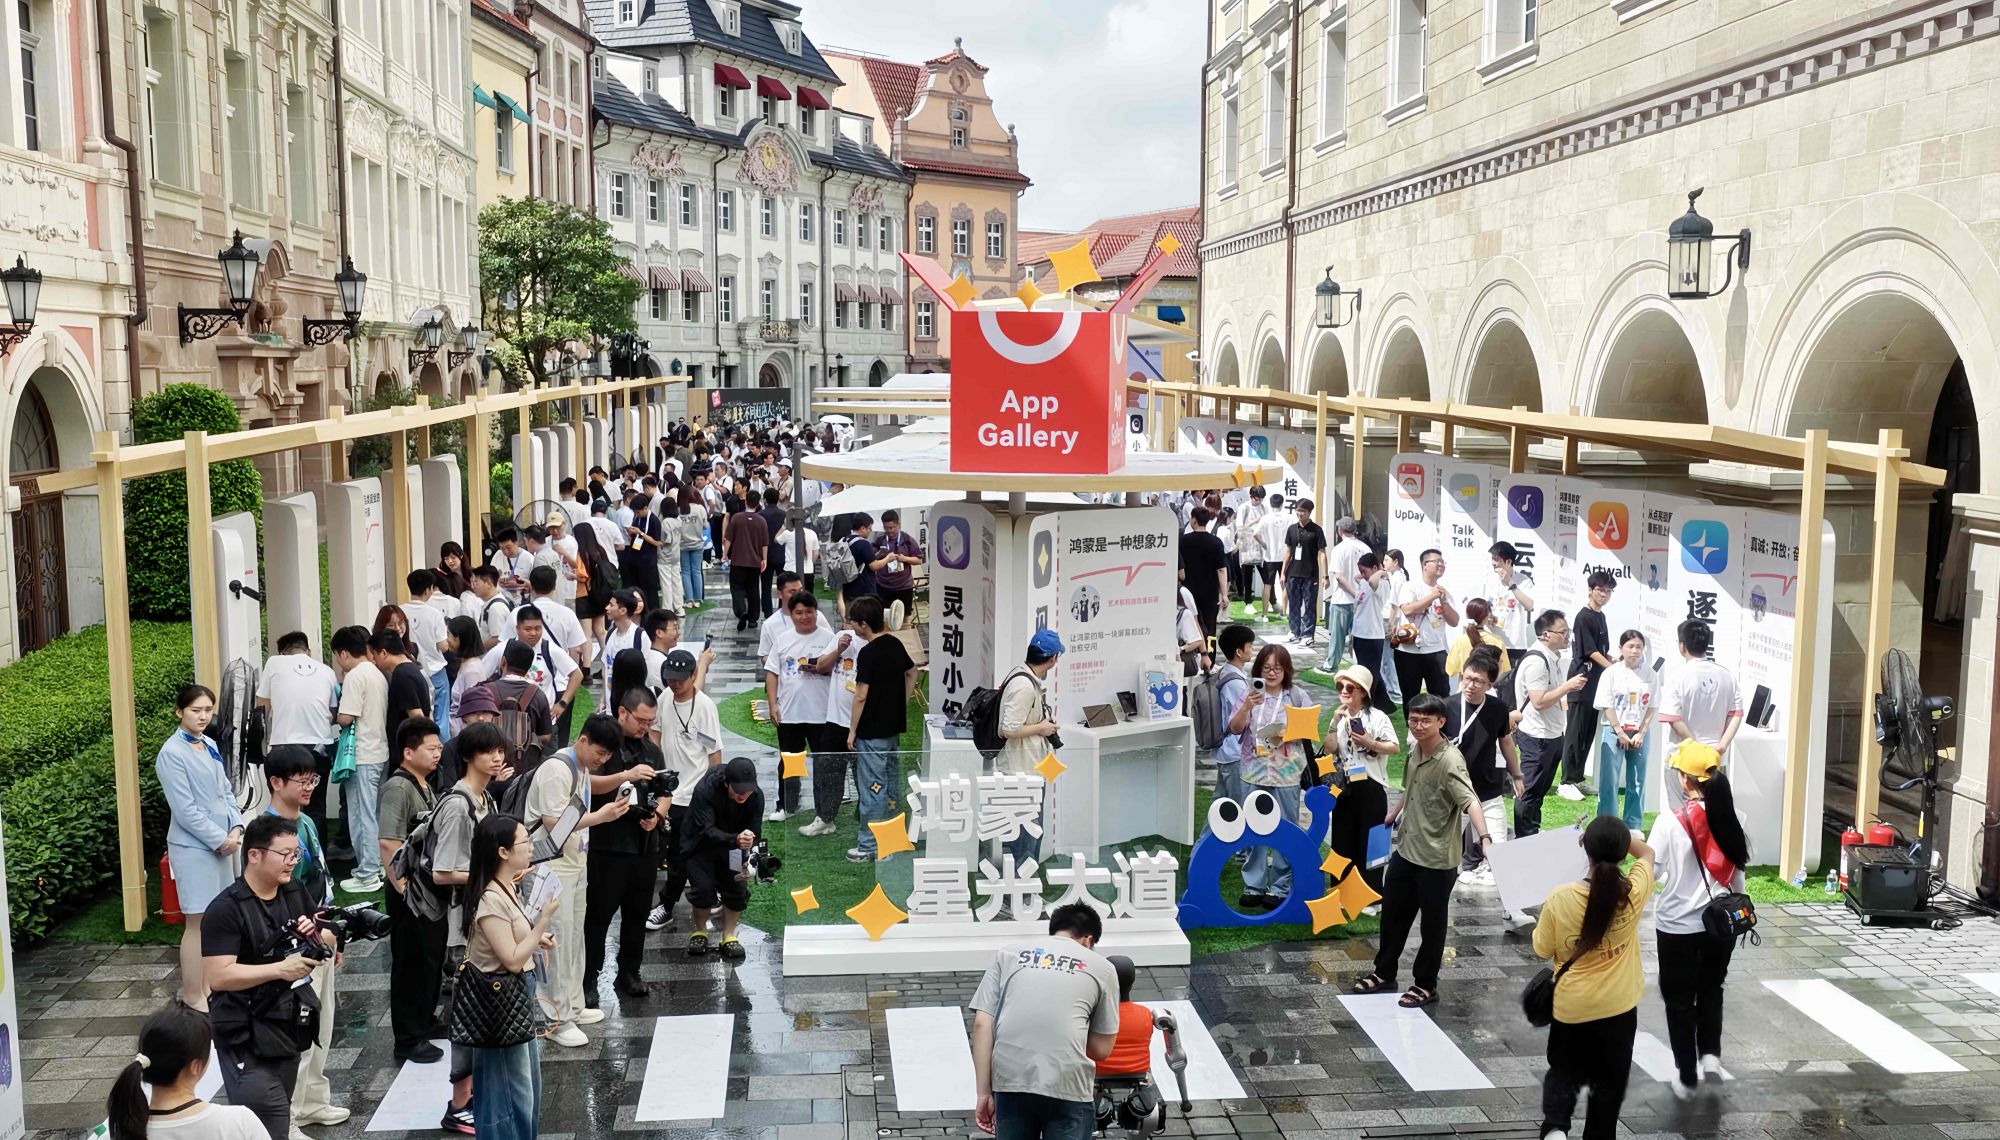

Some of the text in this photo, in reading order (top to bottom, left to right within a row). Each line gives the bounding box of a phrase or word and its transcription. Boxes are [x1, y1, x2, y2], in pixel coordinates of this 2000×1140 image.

[1000, 389, 1059, 419] App
[978, 423, 1079, 454] Gallery
[1395, 509, 1425, 523] UpDay
[1452, 524, 1474, 536] Talk
[1069, 532, 1168, 554] 鸿蒙是一种想象力
[1452, 537, 1474, 548] Talk
[1582, 563, 1631, 579] Artwall
[907, 771, 1045, 843] 鸿蒙
[906, 849, 1179, 923] 星光大道
[1018, 947, 1087, 974] STAFF
